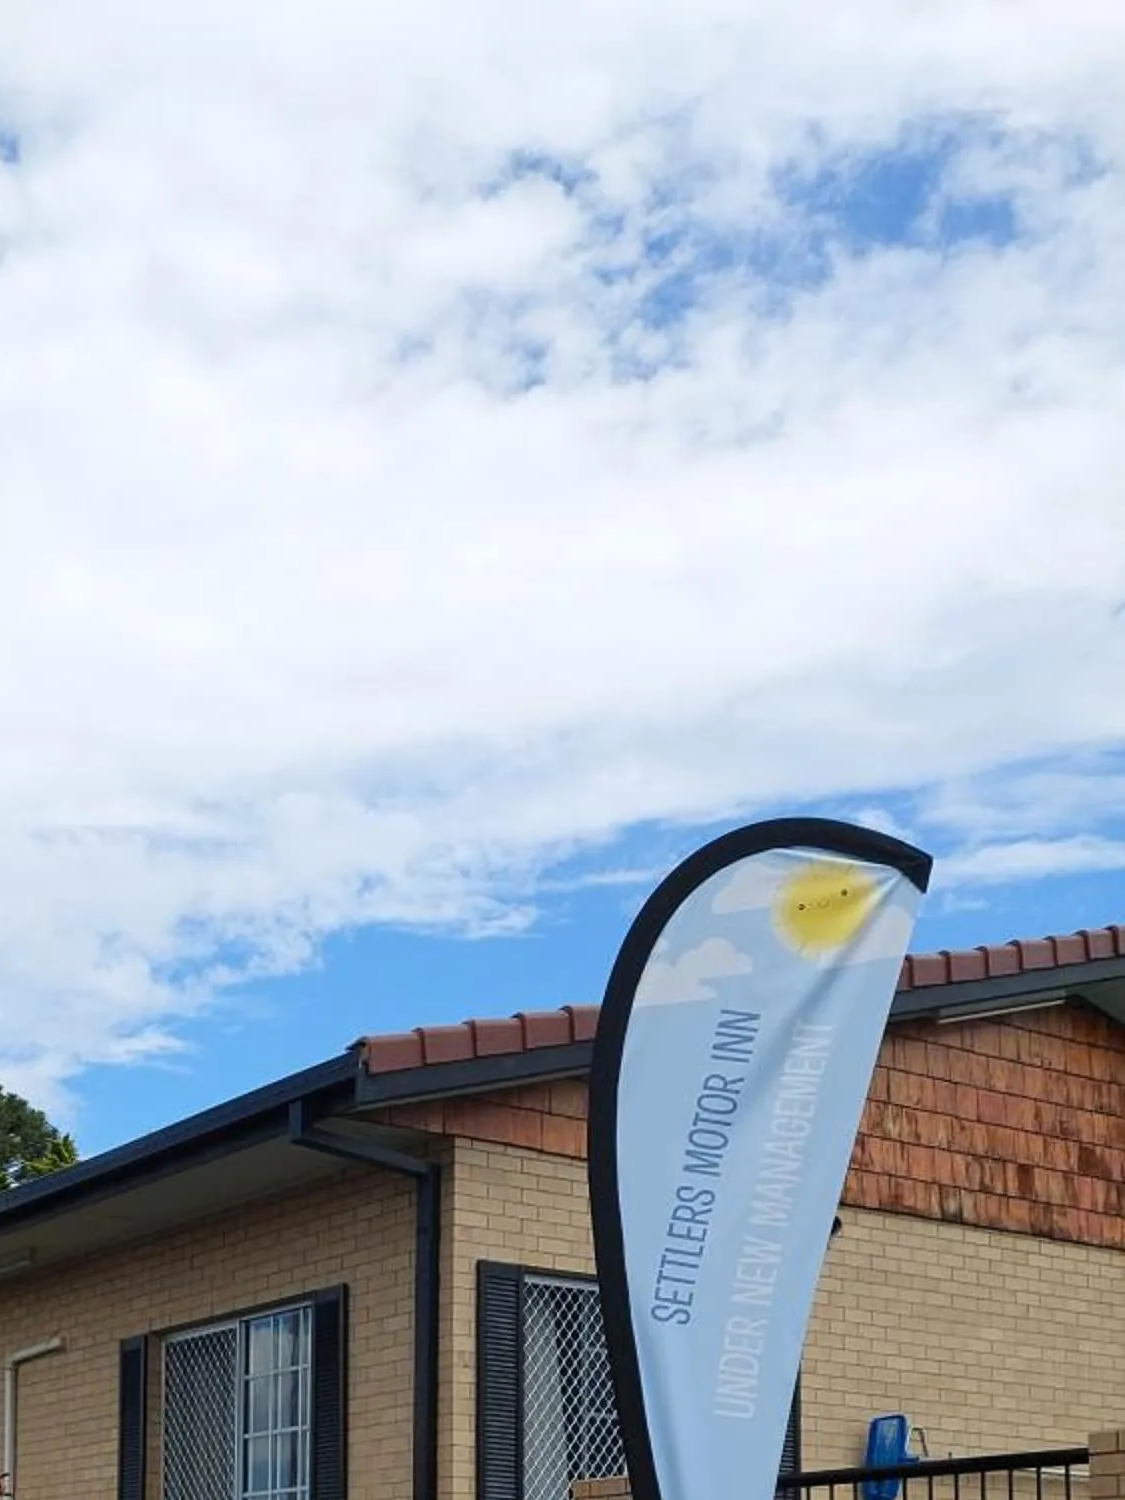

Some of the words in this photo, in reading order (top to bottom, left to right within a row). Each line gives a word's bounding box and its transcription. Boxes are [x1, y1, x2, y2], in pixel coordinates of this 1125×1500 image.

[712, 1009, 761, 1064] INN
[683, 1073, 745, 1178] MOTOR
[750, 1022, 834, 1230] MANAGEMENT
[651, 1185, 715, 1325] SETTLERS
[731, 1218, 782, 1306] NEW
[713, 1313, 765, 1421] UNDER
